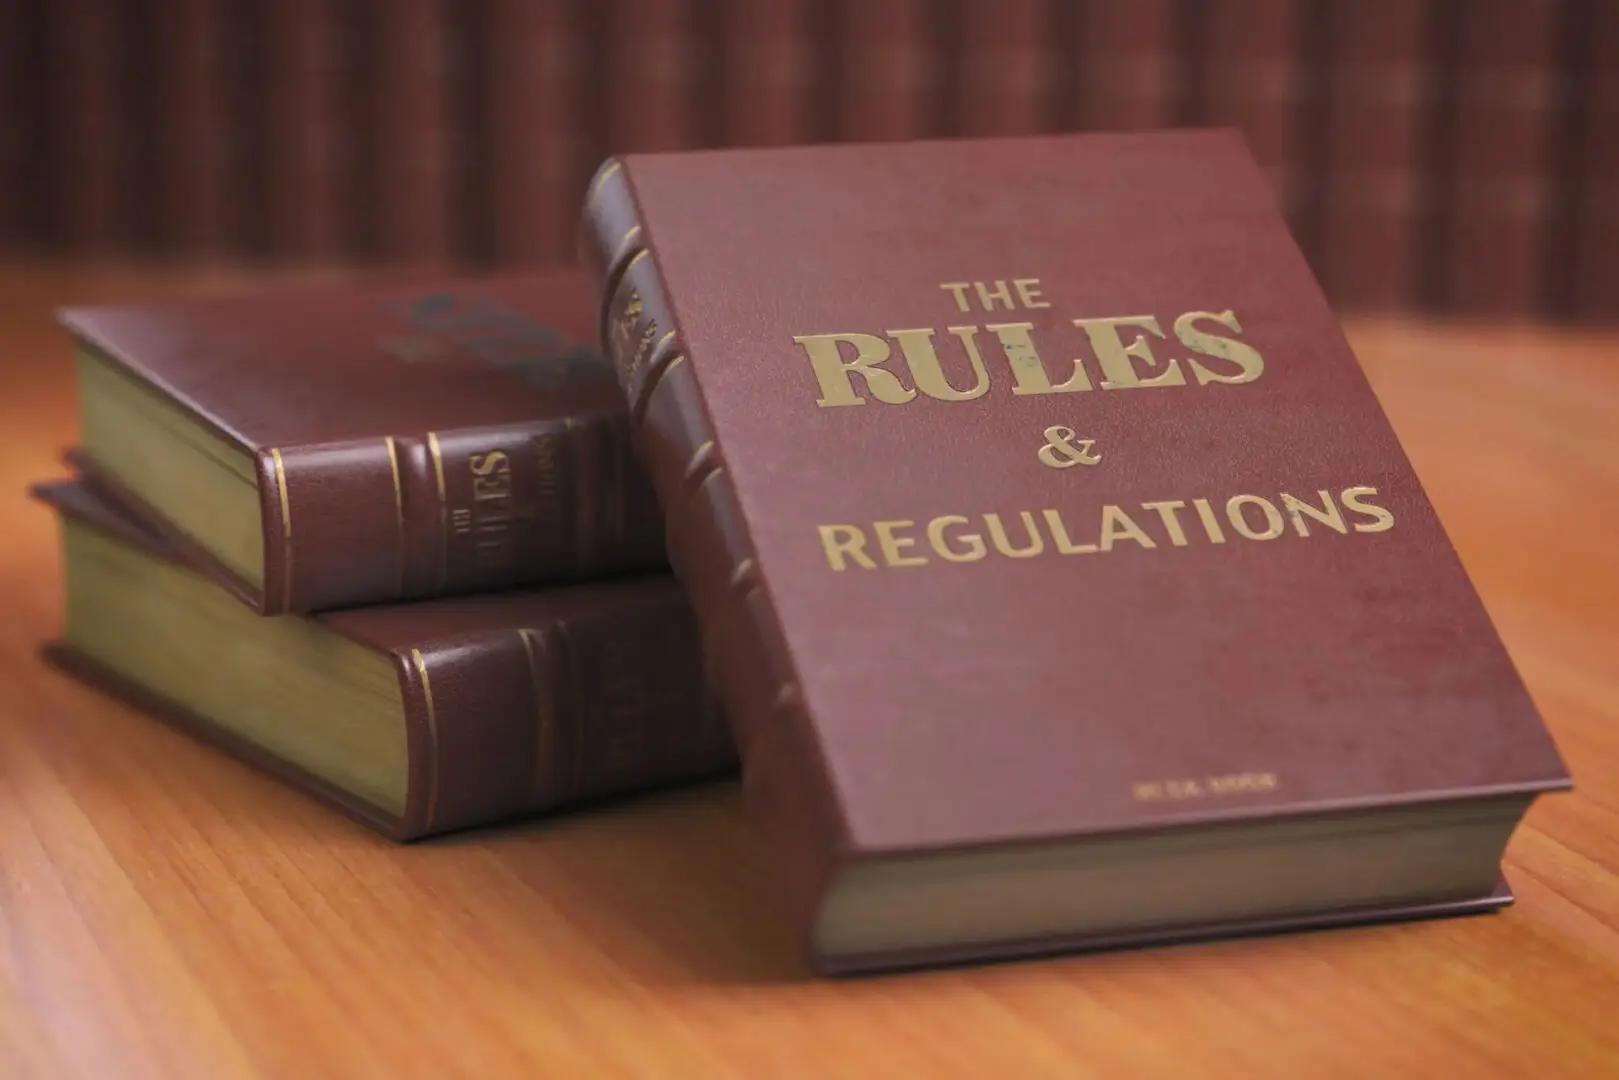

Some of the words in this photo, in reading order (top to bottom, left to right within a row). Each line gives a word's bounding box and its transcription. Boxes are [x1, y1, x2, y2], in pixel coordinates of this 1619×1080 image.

[940, 279, 1051, 313] THE
[793, 309, 1265, 408] RULES
[1038, 425, 1101, 469] &
[817, 486, 1395, 572] REGULATIONS
